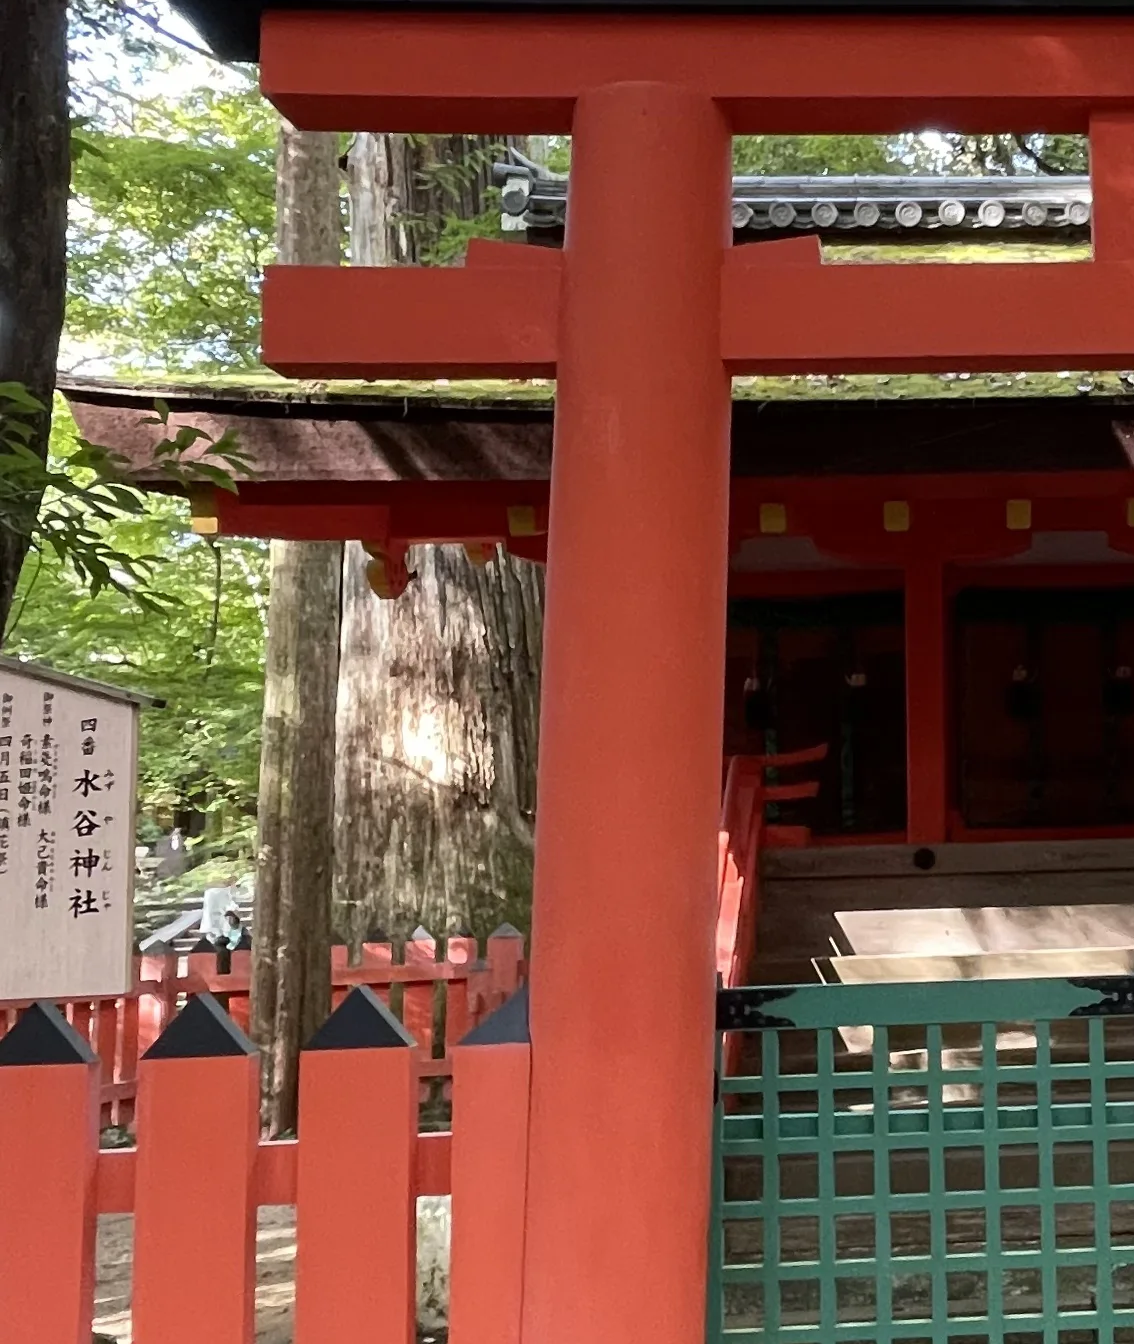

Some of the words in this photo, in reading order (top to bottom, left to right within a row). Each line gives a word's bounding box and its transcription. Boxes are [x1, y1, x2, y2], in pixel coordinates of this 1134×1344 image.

[80, 717, 98, 756] 四番
[69, 769, 102, 918] 水谷神社
